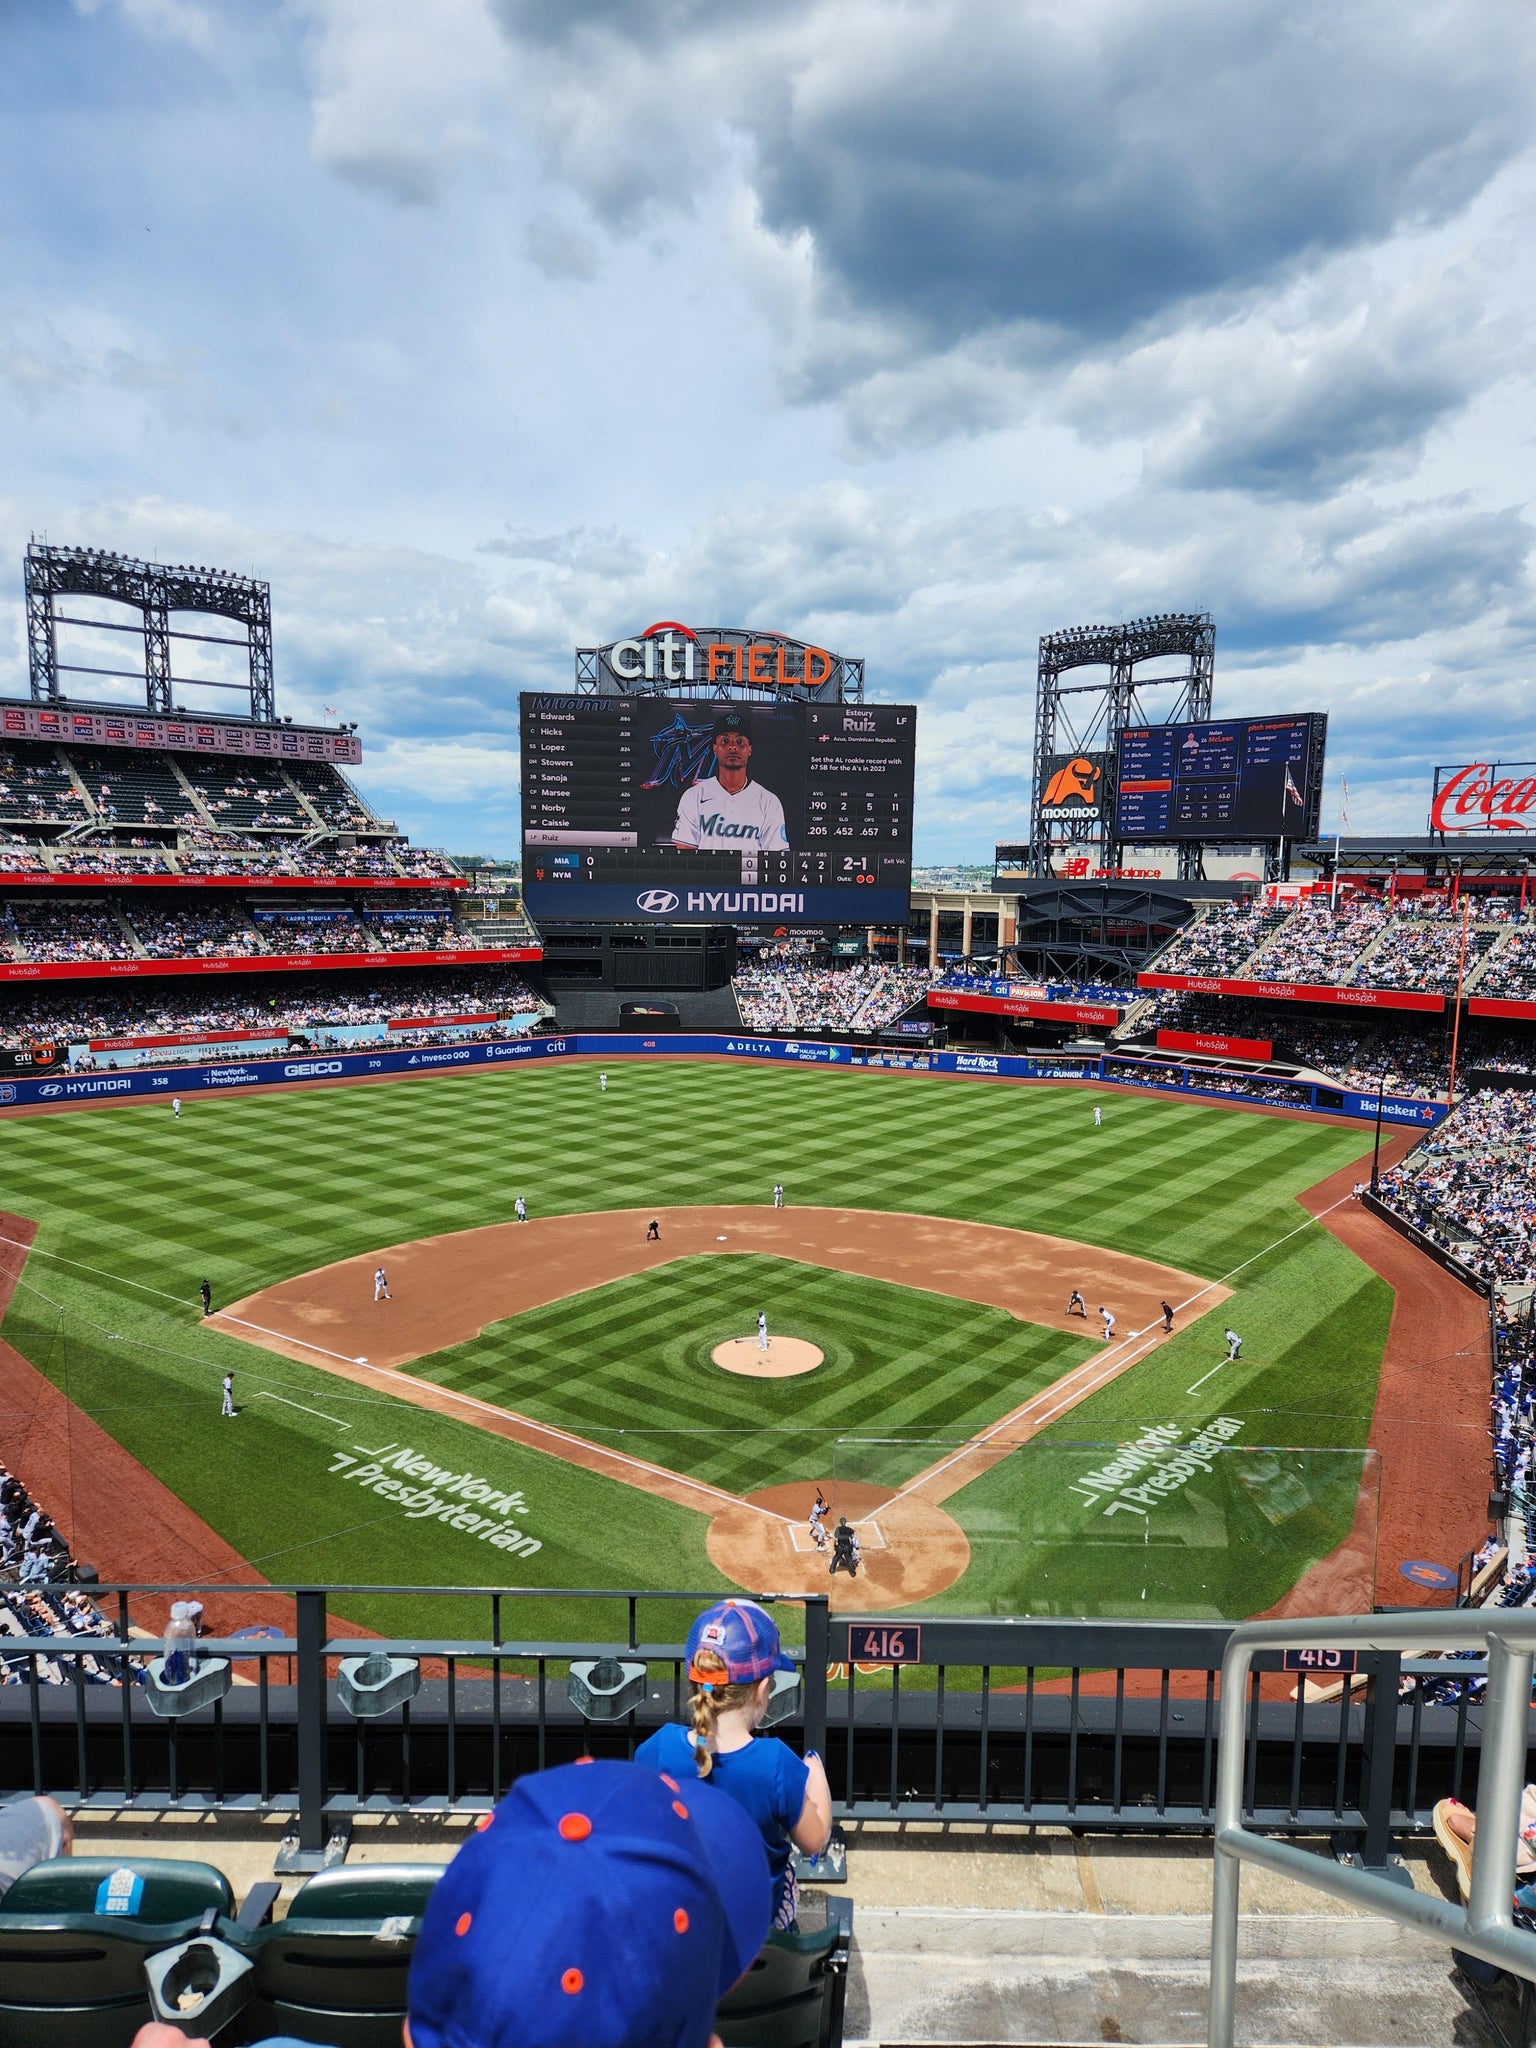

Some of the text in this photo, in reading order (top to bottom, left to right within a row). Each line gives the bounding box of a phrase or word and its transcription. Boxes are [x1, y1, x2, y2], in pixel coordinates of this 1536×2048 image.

[611, 631, 832, 685] citi FIELD
[541, 713, 575, 721] Edwards
[843, 718, 876, 732] Ruiz
[1265, 722, 1295, 730] sequence
[541, 744, 565, 752] Lopez
[542, 774, 568, 783] Sanoja
[1431, 763, 1536, 831] Coca
[542, 804, 566, 813] Norby
[809, 802, 827, 810] .190
[1042, 807, 1099, 819] moomoo
[808, 827, 827, 835] .205
[587, 857, 594, 866] 0
[801, 861, 808, 869] 4
[818, 862, 824, 870] 2
[843, 857, 867, 870] 2-1
[588, 871, 593, 879] 1
[1092, 867, 1161, 878] new balance
[104, 876, 132, 884] HubSpot
[178, 877, 206, 885] HubSpot
[688, 892, 804, 912] HYUNDAI
[9, 968, 41, 976] HubSpot
[110, 964, 138, 972] HubSpot
[996, 984, 1007, 994] citi
[1188, 980, 1221, 991] HubSpot
[1259, 985, 1295, 997] HubSpot
[936, 997, 958, 1005] HubSpot
[1337, 991, 1377, 1003] HubSpot
[1004, 1004, 1029, 1012] HubSpot
[1077, 1011, 1104, 1020] HubSpot
[105, 1040, 134, 1048] HubSpot
[547, 1040, 566, 1052] citi
[738, 1042, 771, 1052] DELTA
[1196, 1039, 1228, 1051] HubSpot
[495, 1046, 532, 1055] Guardian
[15, 1051, 32, 1062] citi
[422, 1051, 470, 1062] Invesco QQQ
[956, 1056, 998, 1068] Hard Rock
[211, 1068, 248, 1076] NewYork-
[284, 1062, 342, 1076] GEICO
[152, 1078, 168, 1086] 358
[211, 1074, 258, 1085] Presbyterian
[1119, 1079, 1158, 1089] CADILLAC
[67, 1079, 131, 1093] HYUNDAI
[1266, 1100, 1312, 1111] CADILLAC
[1360, 1100, 1417, 1117] Heineken
[1119, 1417, 1245, 1505] Presbyterian
[379, 1448, 530, 1516] NewYork-
[343, 1463, 543, 1558] Presbyterian
[864, 1631, 904, 1657] 416
